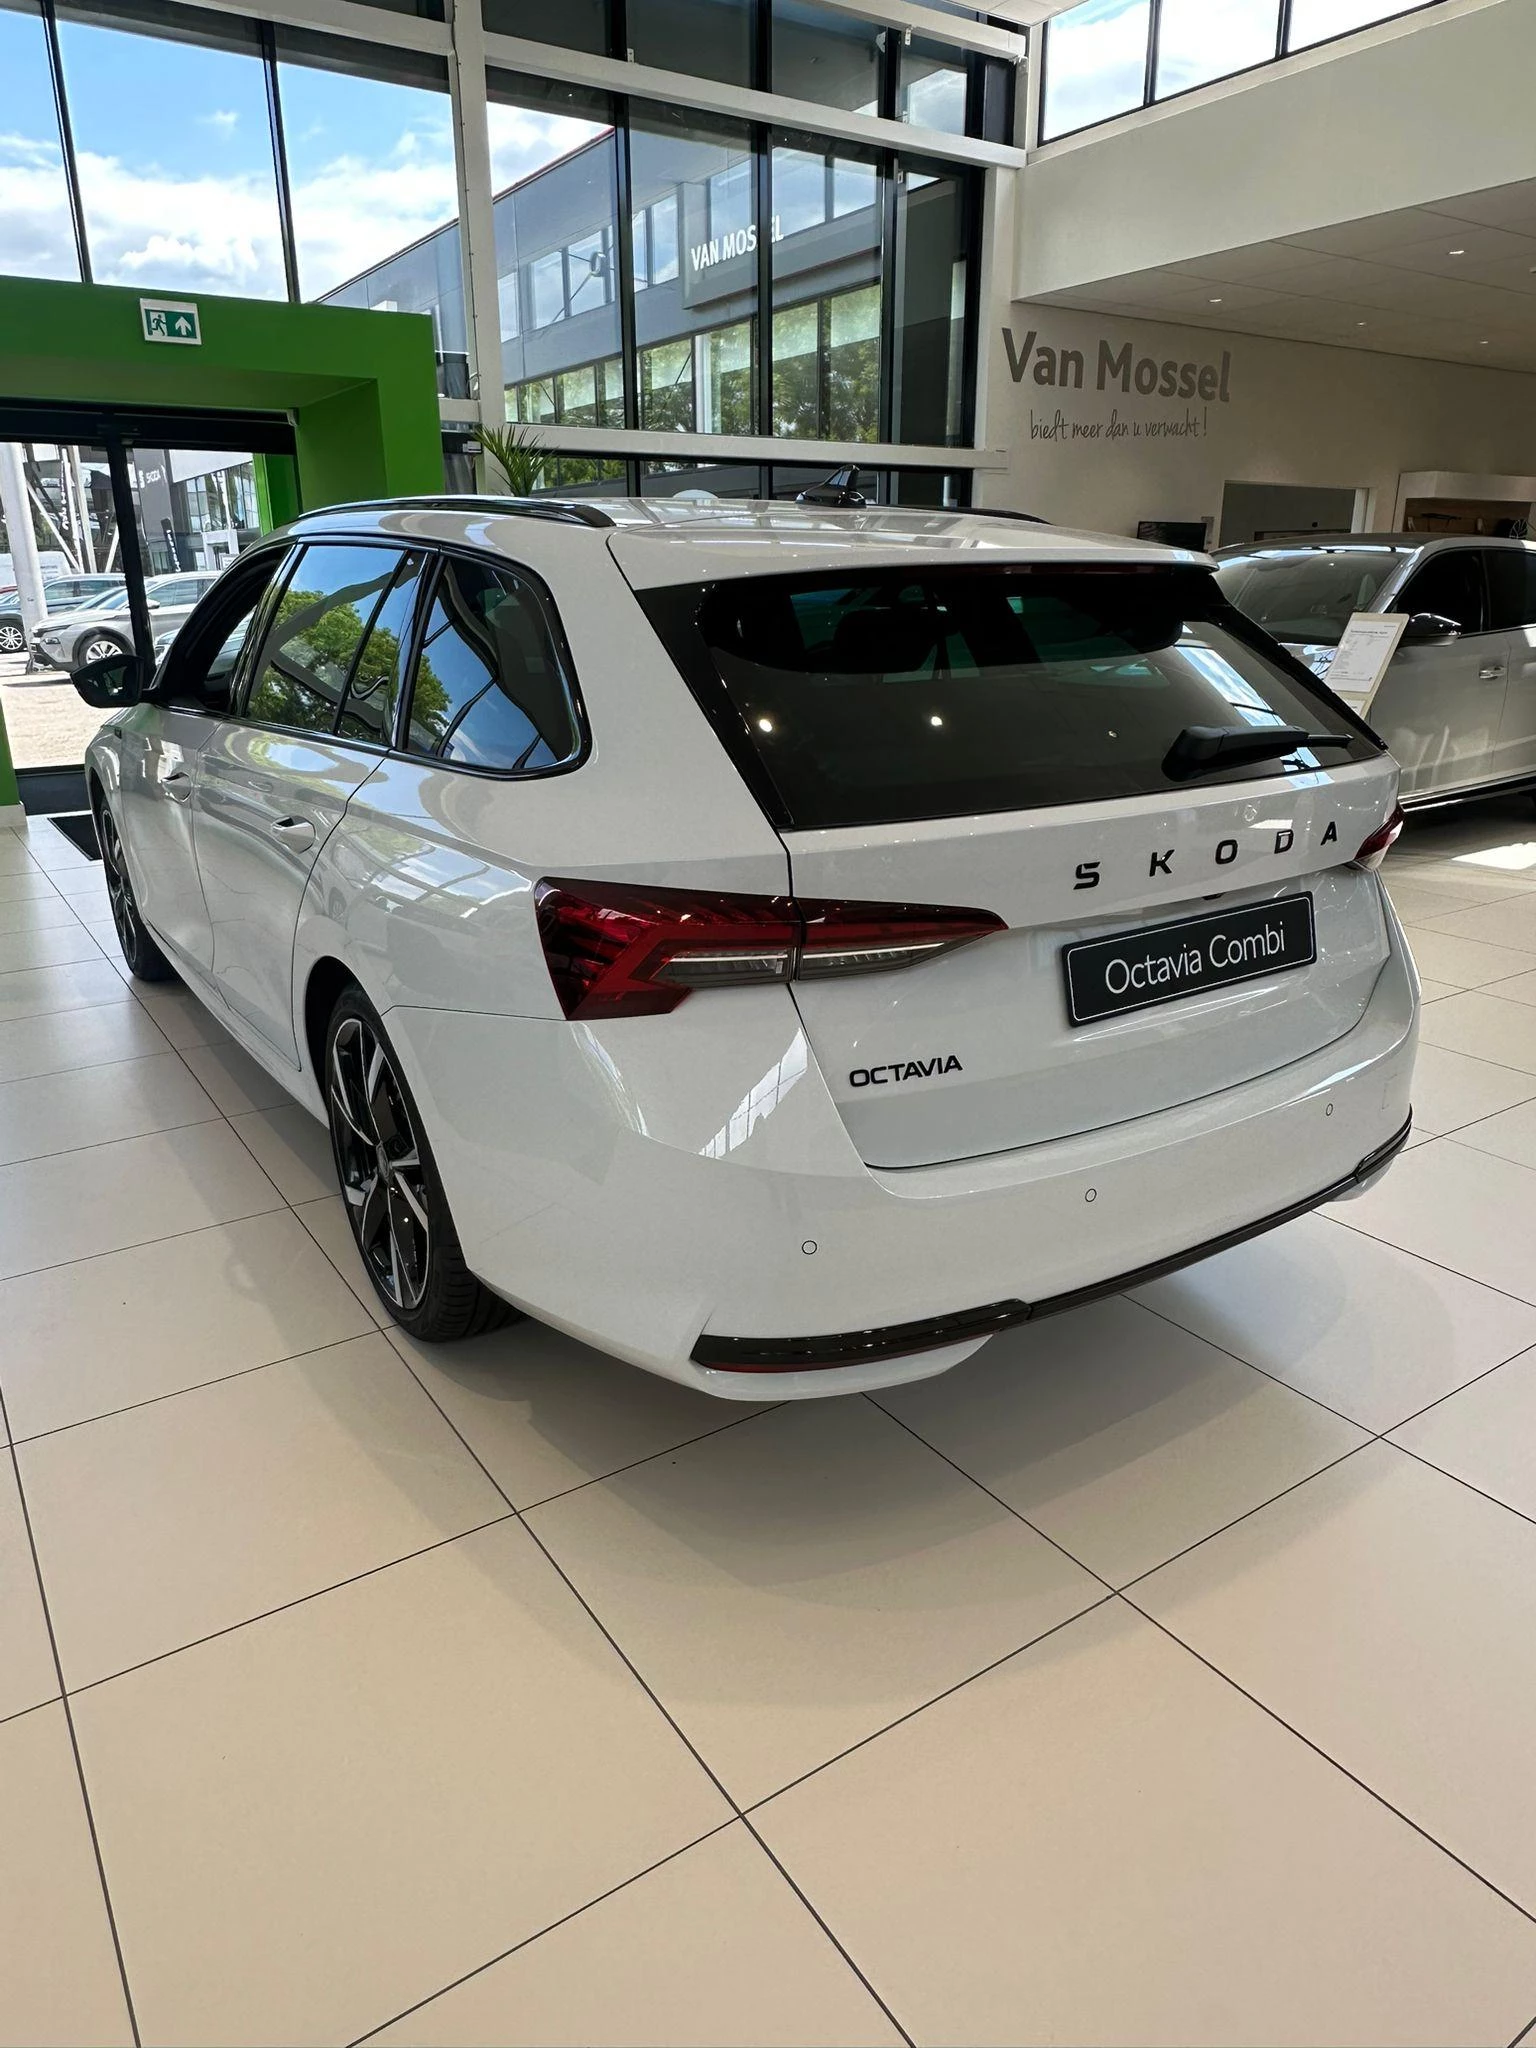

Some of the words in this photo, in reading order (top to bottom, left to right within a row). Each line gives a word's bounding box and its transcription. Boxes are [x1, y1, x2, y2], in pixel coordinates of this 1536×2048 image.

[690, 238, 719, 272] VAN
[722, 215, 785, 261] MOSL
[1001, 327, 1085, 389] Van
[1096, 339, 1232, 403] Mossel
[1030, 409, 1069, 442] biedt
[1071, 421, 1103, 439] meer
[1105, 408, 1130, 440] dan
[1133, 420, 1142, 435] u
[1105, 944, 1203, 994] Octavia
[1209, 921, 1286, 968] Combi
[849, 1055, 963, 1087] OCTAVIA
